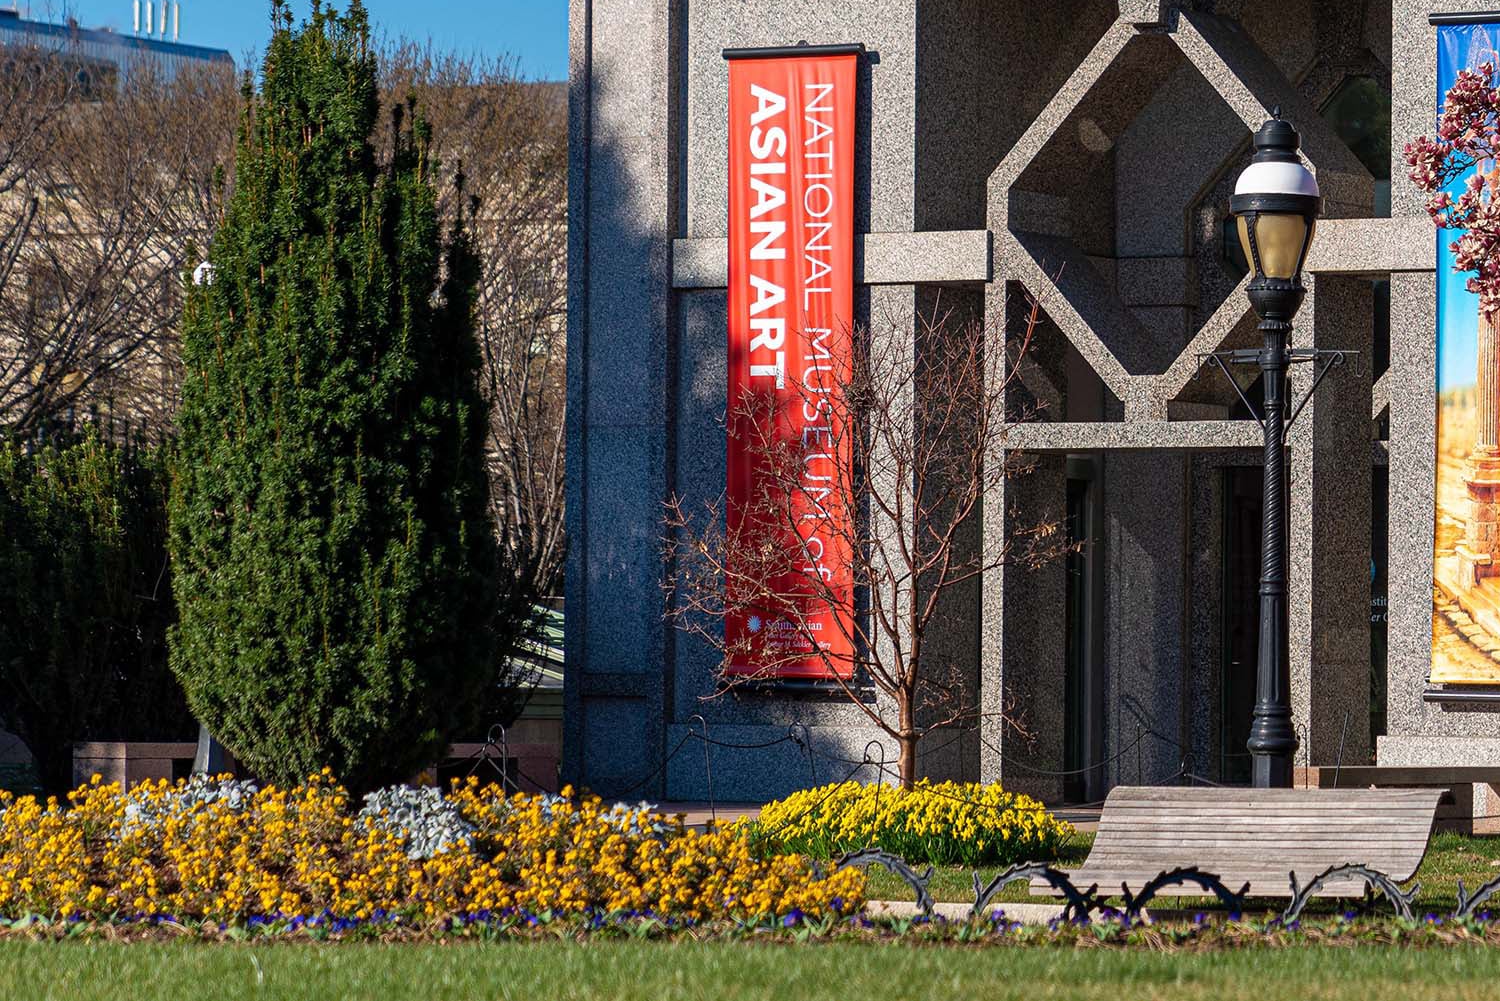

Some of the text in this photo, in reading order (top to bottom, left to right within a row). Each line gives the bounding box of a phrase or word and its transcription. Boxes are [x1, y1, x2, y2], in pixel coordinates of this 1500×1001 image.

[750, 83, 787, 390] ASIAN ART
[802, 83, 834, 582] NATIONAL MUSEUM of
